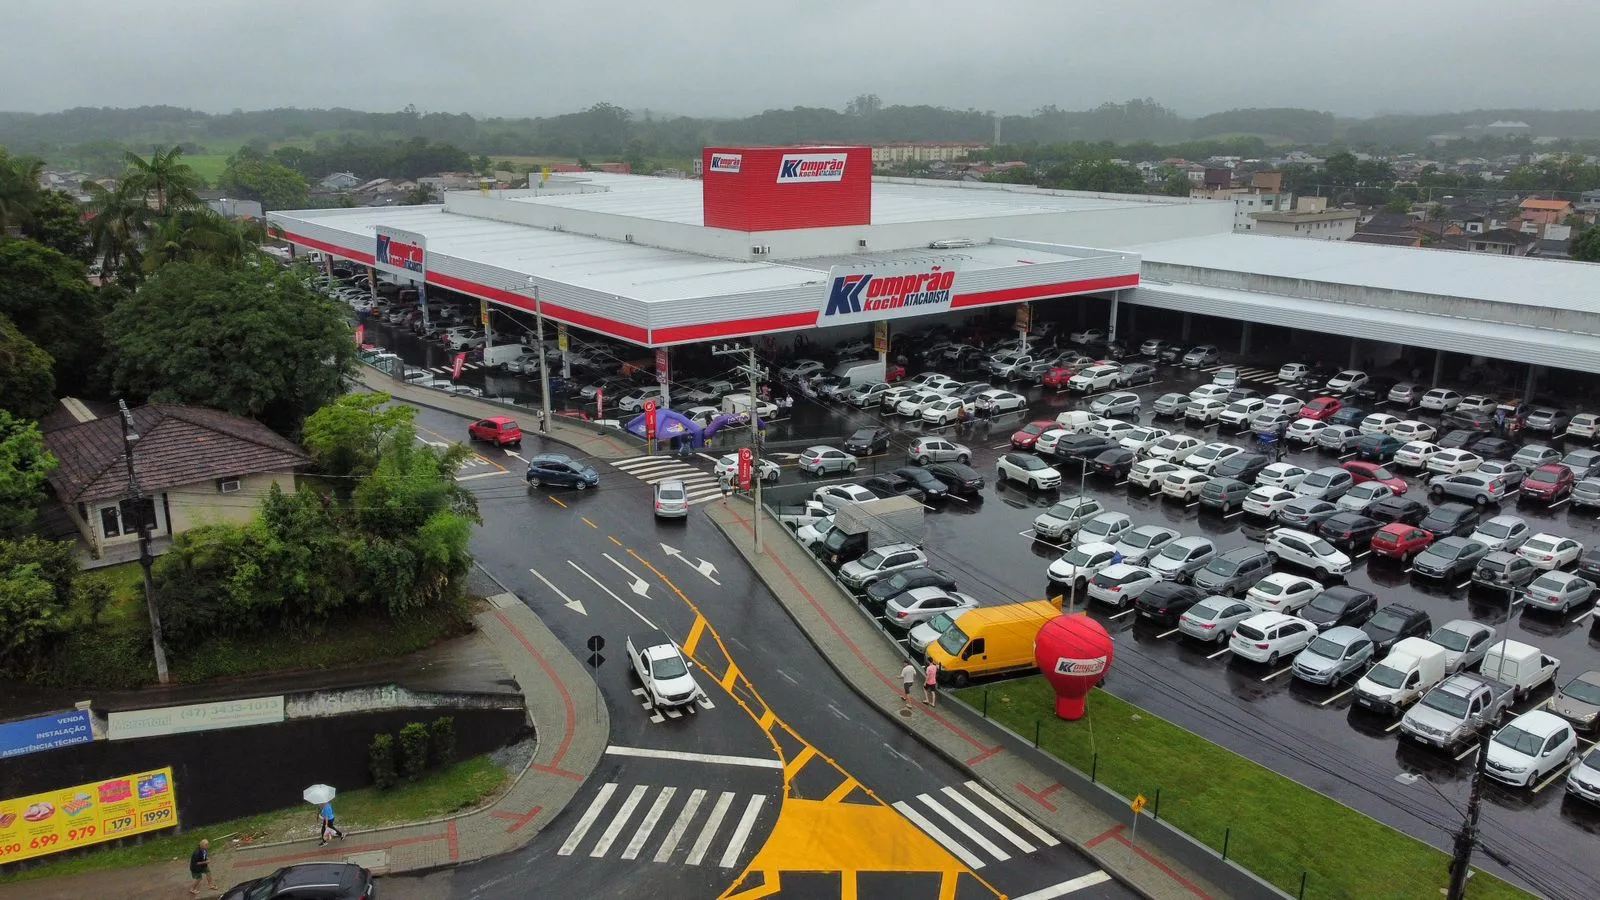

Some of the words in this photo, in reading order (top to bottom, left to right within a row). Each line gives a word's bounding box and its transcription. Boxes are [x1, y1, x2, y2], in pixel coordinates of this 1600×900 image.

[904, 290, 949, 307] ATACADISTA
[57, 715, 85, 725] VENDA
[36, 725, 86, 739] INSTALAÇÃO
[2, 742, 53, 757] ASSISTÊNCIA
[54, 735, 88, 747] TÉCNICA
[30, 833, 59, 849] 6,99
